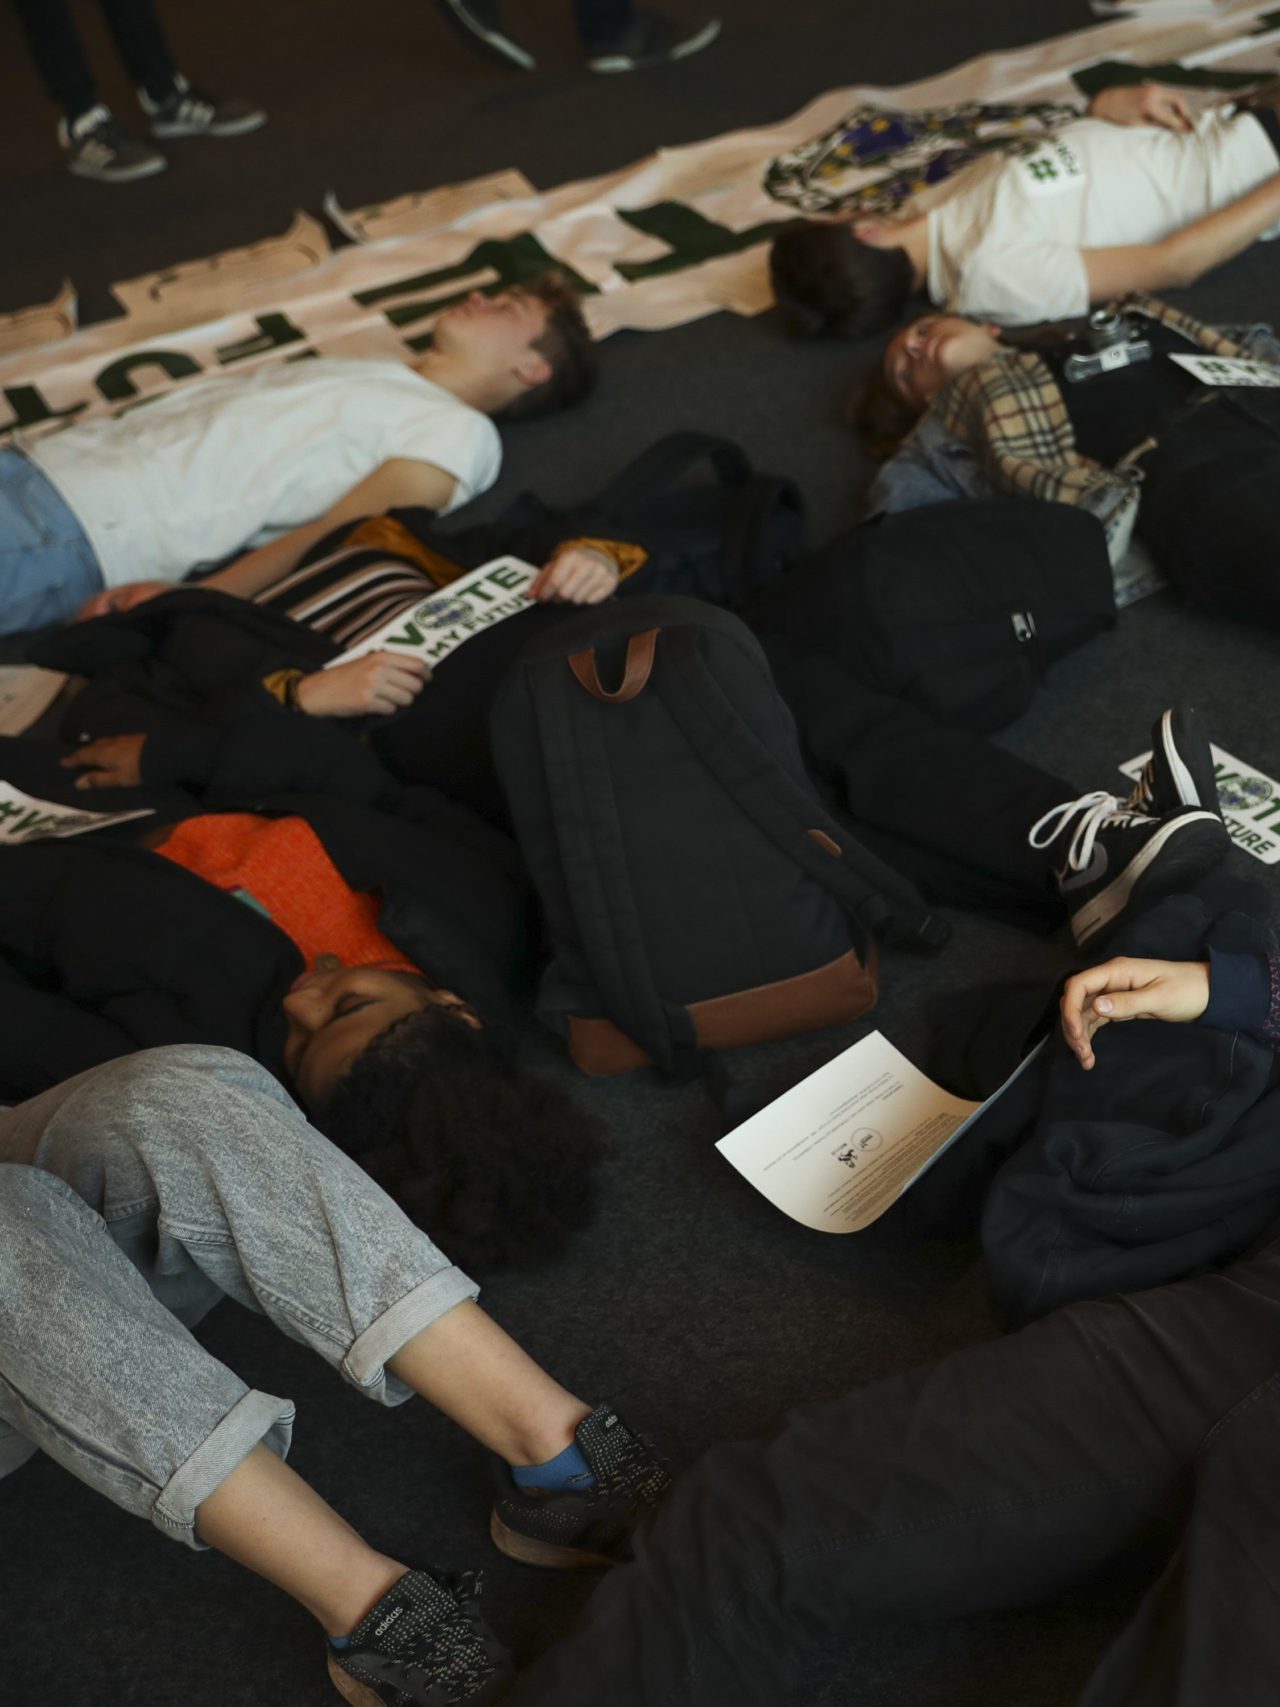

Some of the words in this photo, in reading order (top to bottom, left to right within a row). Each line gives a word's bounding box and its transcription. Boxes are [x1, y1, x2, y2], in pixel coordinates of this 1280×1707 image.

[368, 565, 530, 652] VOTE
[426, 630, 461, 658] MY
[1223, 815, 1276, 854] TURE
[375, 1606, 403, 1636] adidas
